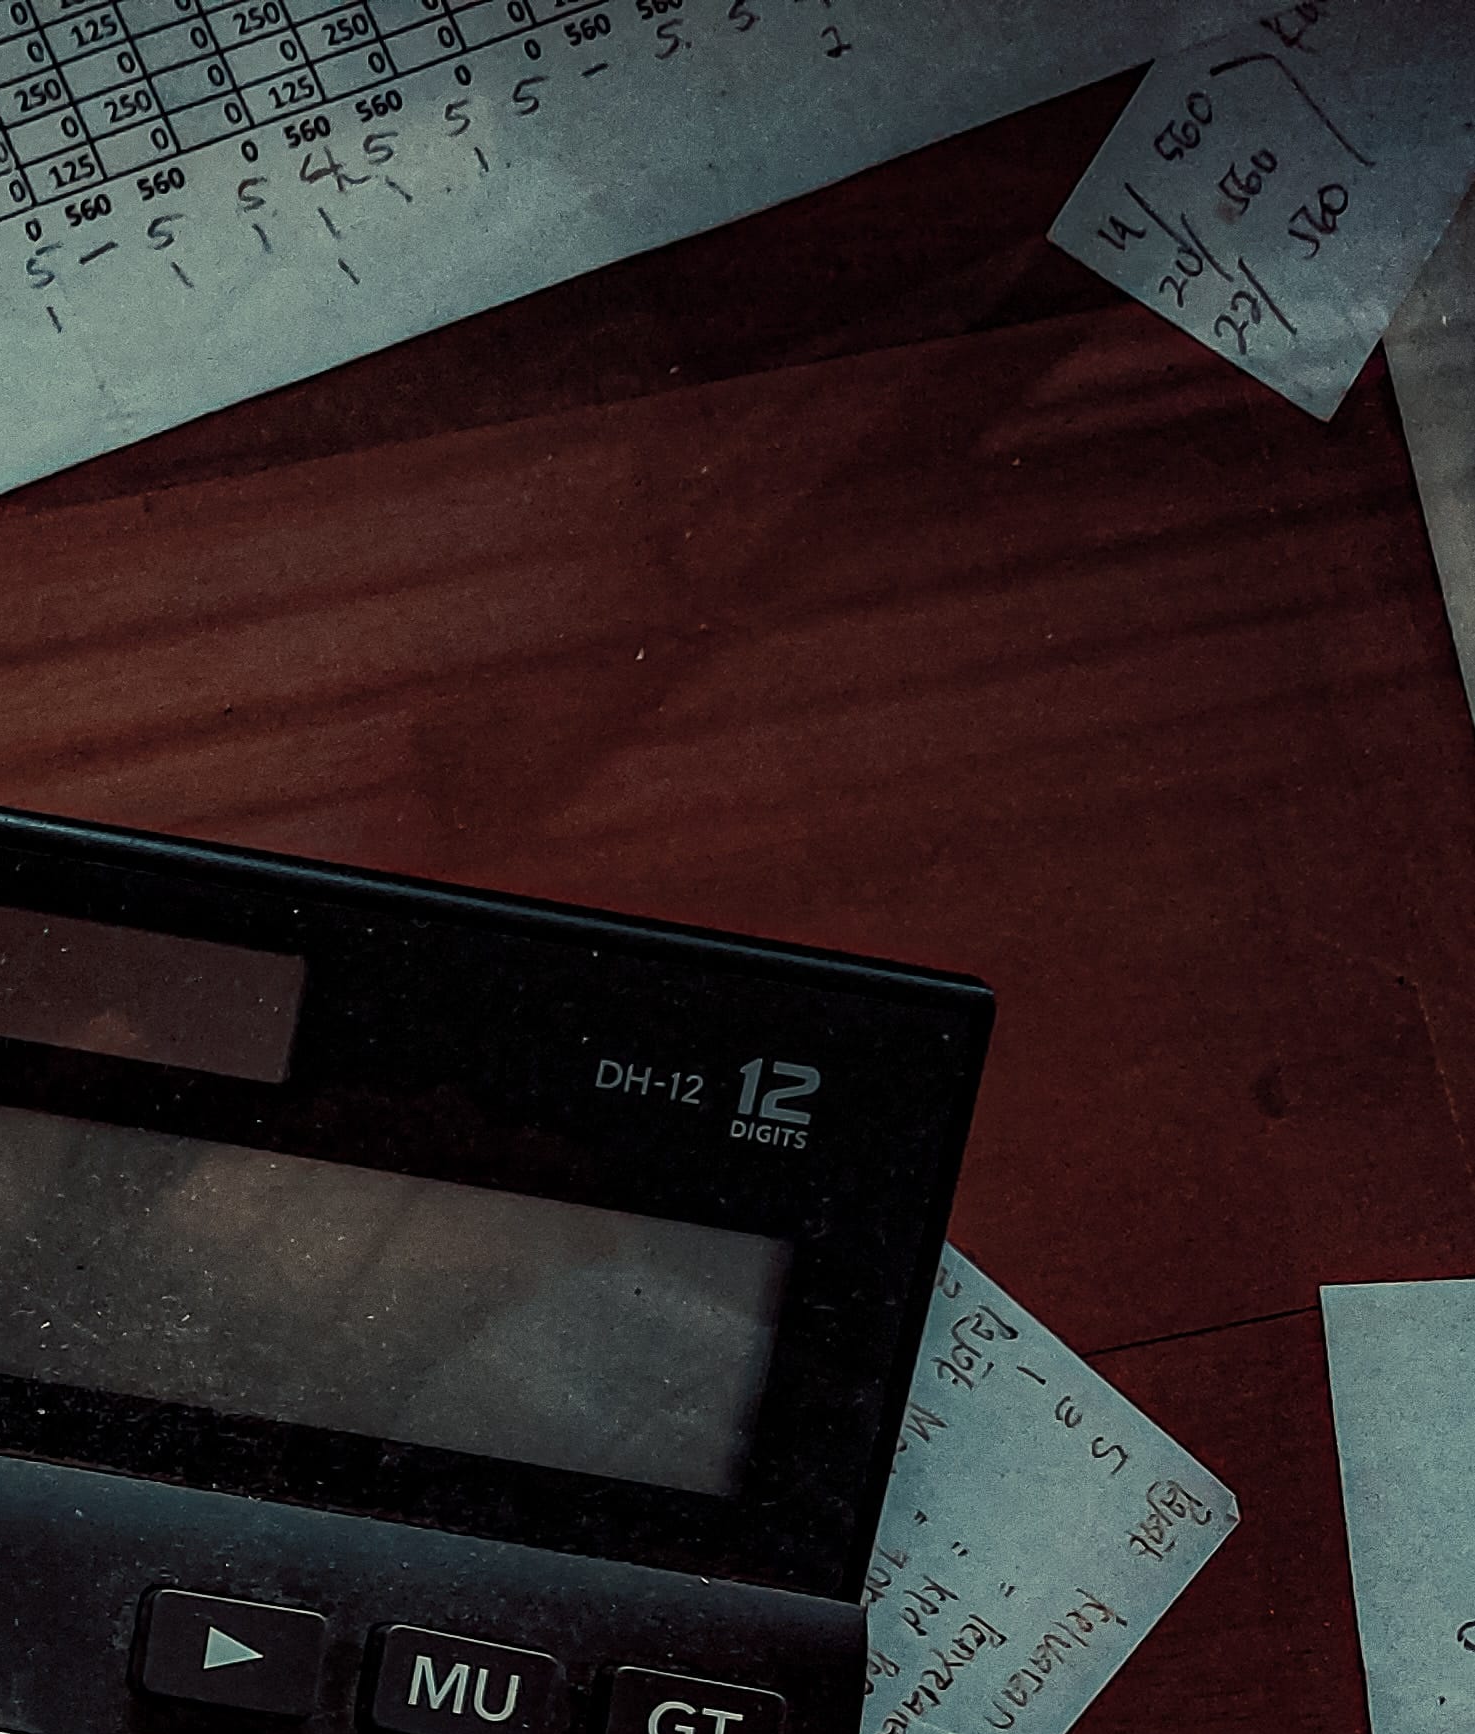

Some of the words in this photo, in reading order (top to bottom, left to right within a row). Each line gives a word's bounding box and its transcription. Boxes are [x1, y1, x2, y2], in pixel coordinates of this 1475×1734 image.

[595, 1059, 705, 1105] DH-12
[737, 1057, 821, 1125] 12
[729, 1119, 810, 1150] DIGITS
[407, 1655, 522, 1723] MU
